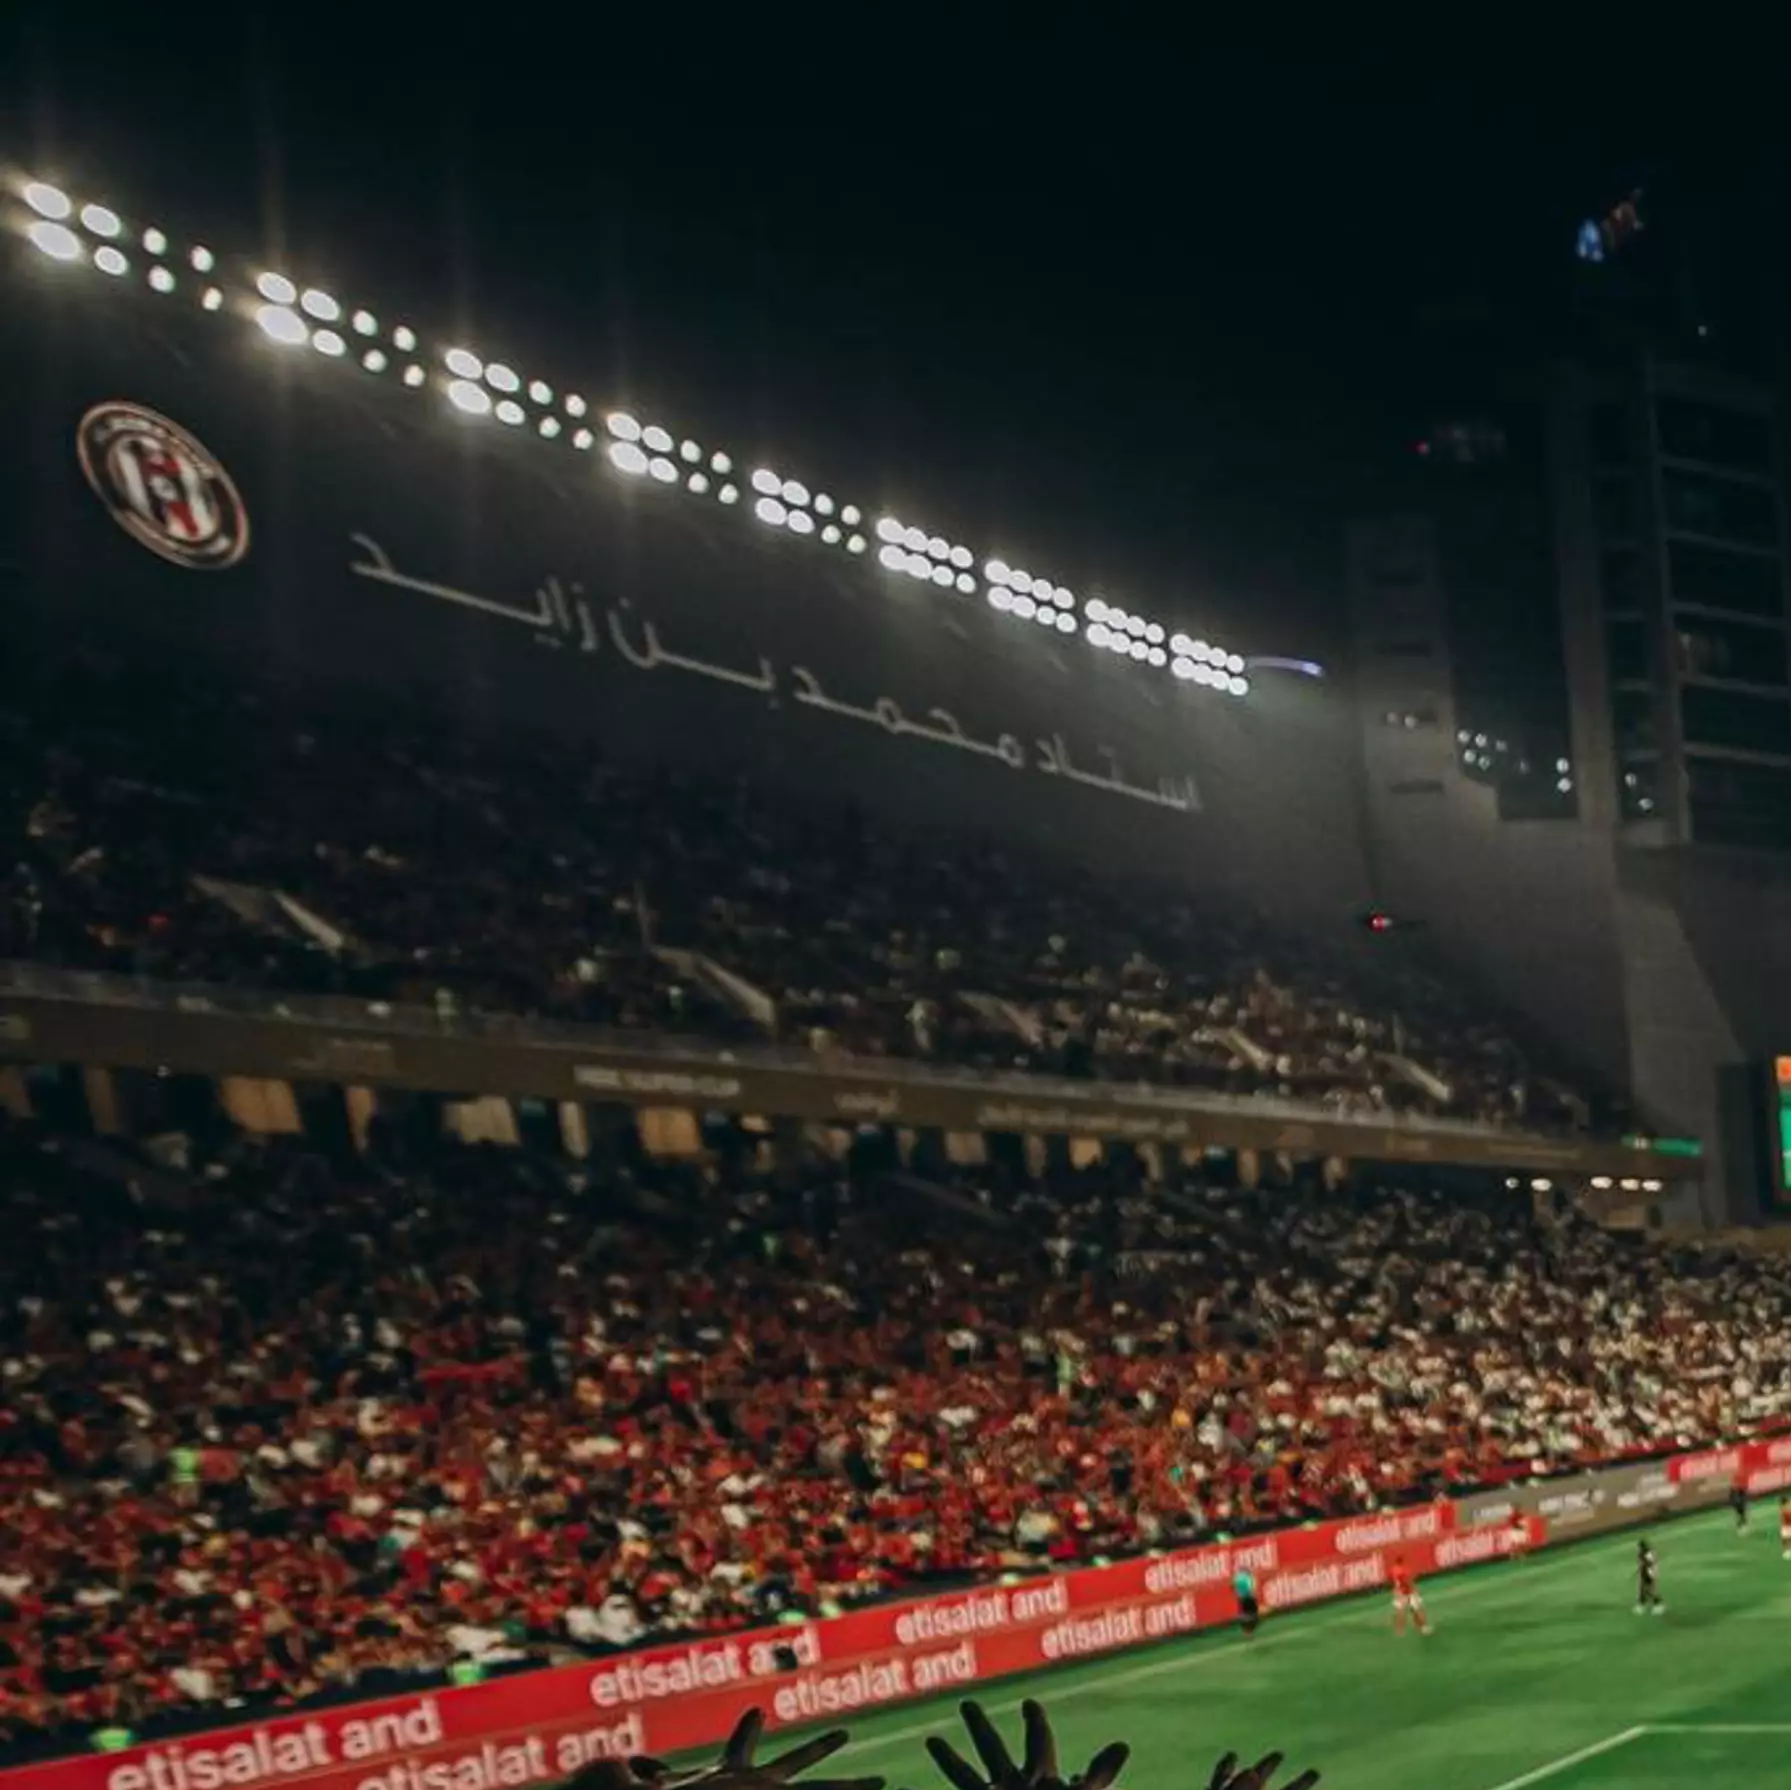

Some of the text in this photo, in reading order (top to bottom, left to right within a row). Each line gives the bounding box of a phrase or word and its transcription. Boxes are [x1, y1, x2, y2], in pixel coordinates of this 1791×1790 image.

[348, 532, 598, 652] زايد
[606, 597, 779, 710] بن
[791, 664, 1025, 769] محمد
[894, 1578, 1068, 1645] etisalat and
[1041, 1594, 1197, 1659] etisalat and
[589, 1625, 823, 1706] etisalat ad
[773, 1640, 978, 1721] etisalat and
[339, 1697, 445, 1761] and
[555, 1710, 647, 1773] and
